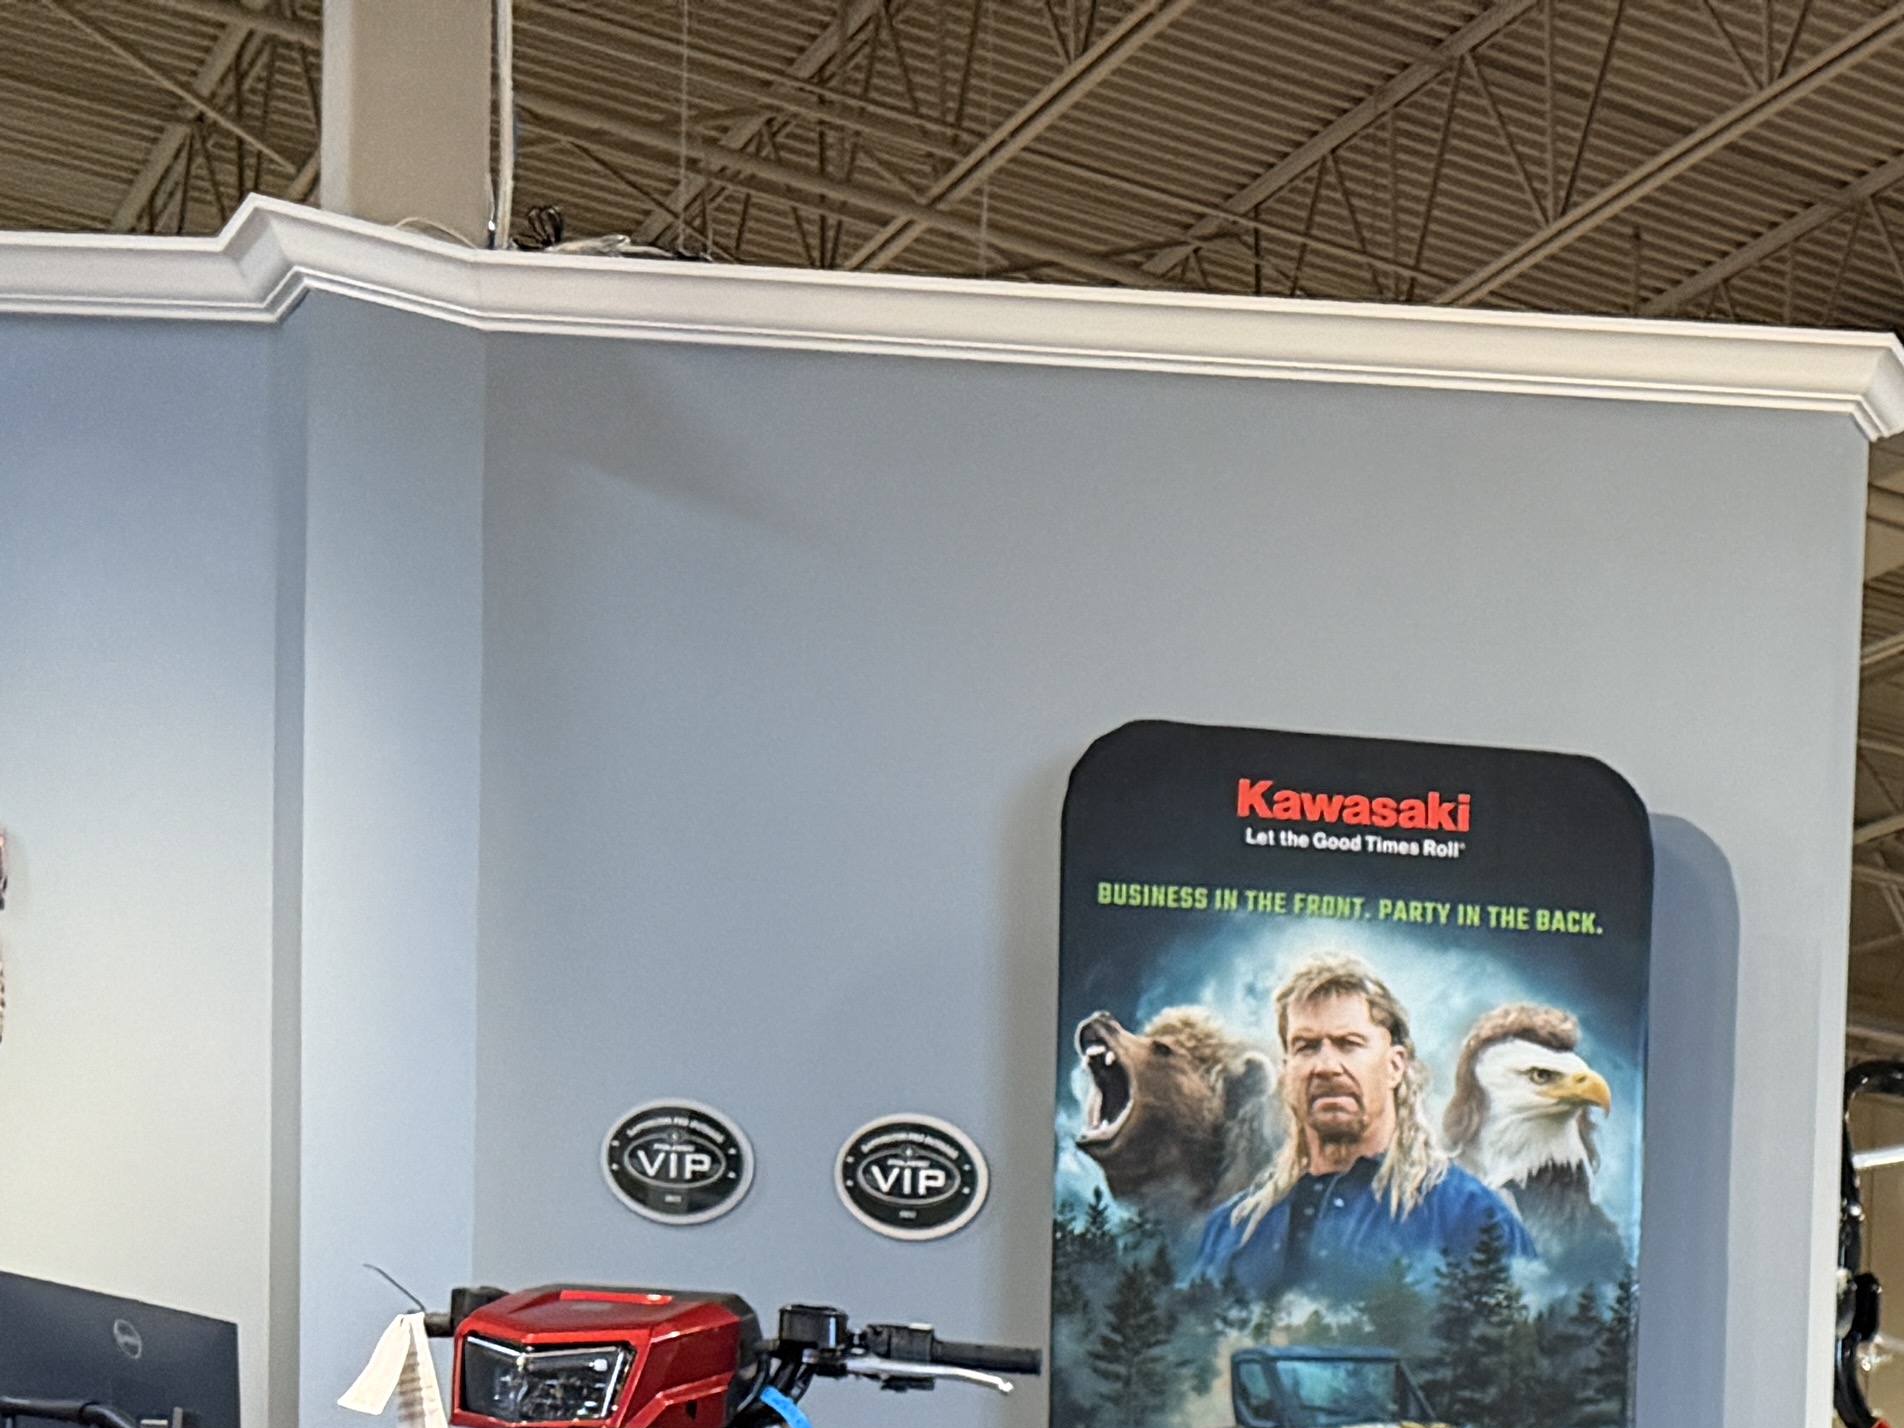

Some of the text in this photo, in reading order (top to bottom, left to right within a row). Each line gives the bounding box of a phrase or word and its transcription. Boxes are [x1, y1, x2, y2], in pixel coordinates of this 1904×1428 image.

[1236, 778, 1472, 832] Kawasaki
[1245, 827, 1275, 846] Let
[1280, 830, 1309, 848] the
[1313, 831, 1362, 851] Good
[1365, 835, 1420, 856] Times
[1097, 881, 1605, 935] BUSINESS IN THE FRONT. PARTY IN THE BACK.
[636, 1149, 712, 1180] VIP
[869, 1165, 946, 1195] VIP
